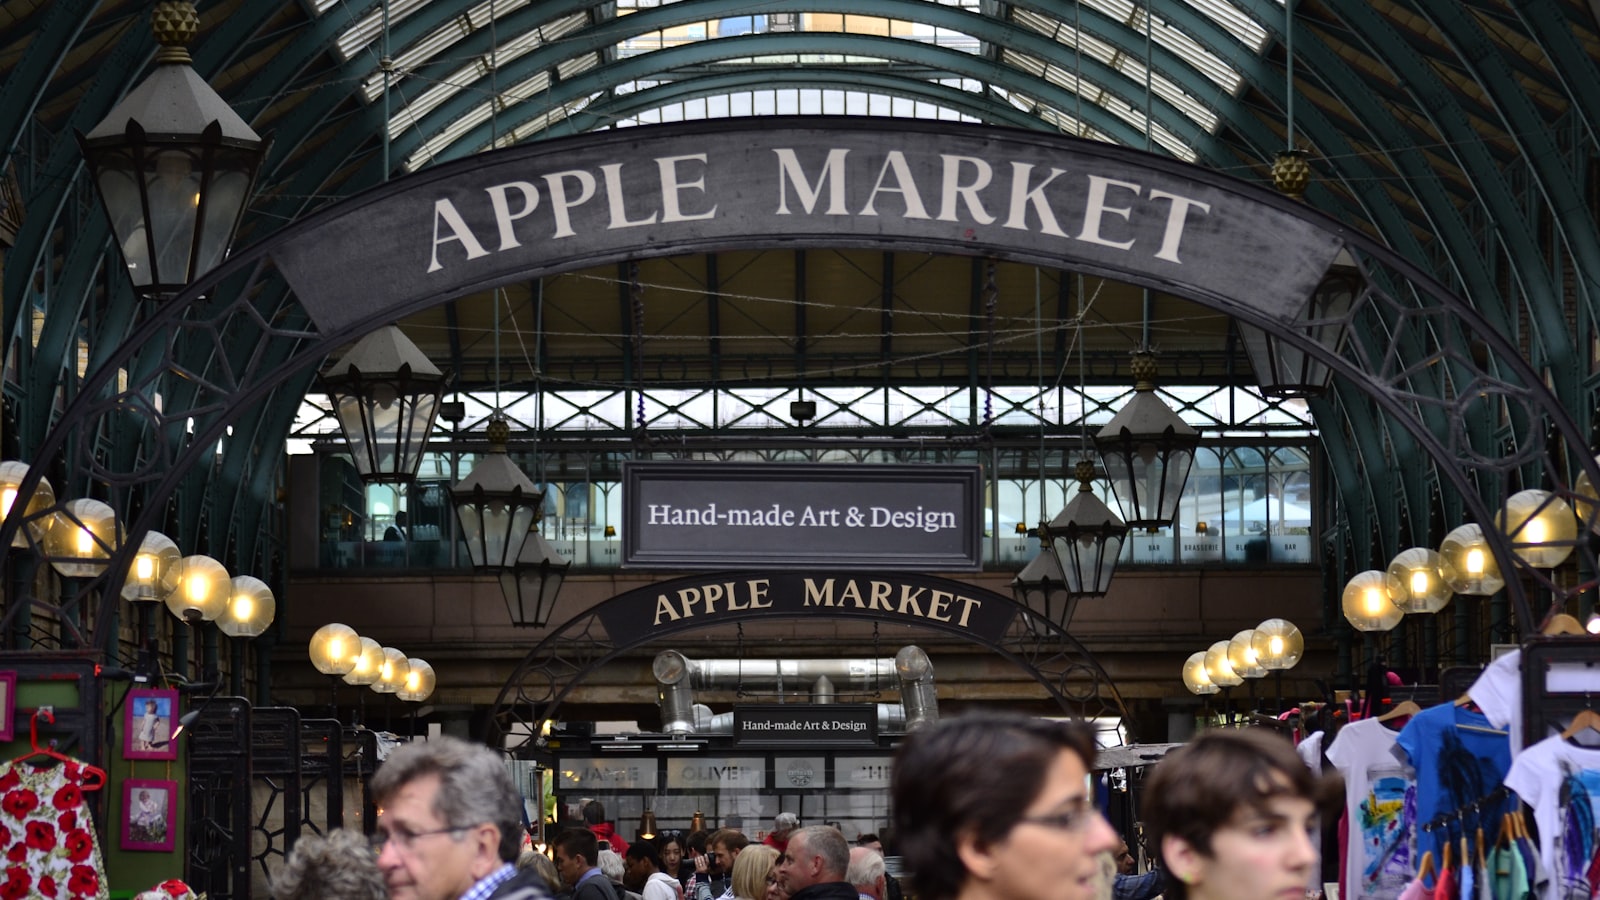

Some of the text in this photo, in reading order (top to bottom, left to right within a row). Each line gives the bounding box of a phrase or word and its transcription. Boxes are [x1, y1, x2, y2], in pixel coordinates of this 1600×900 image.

[425, 147, 1211, 273] APPLE MARKET
[647, 503, 957, 533] Hand-made Art & Design
[653, 578, 982, 628] APPLE MARKET
[742, 720, 867, 732] Hand-made Art & Design
